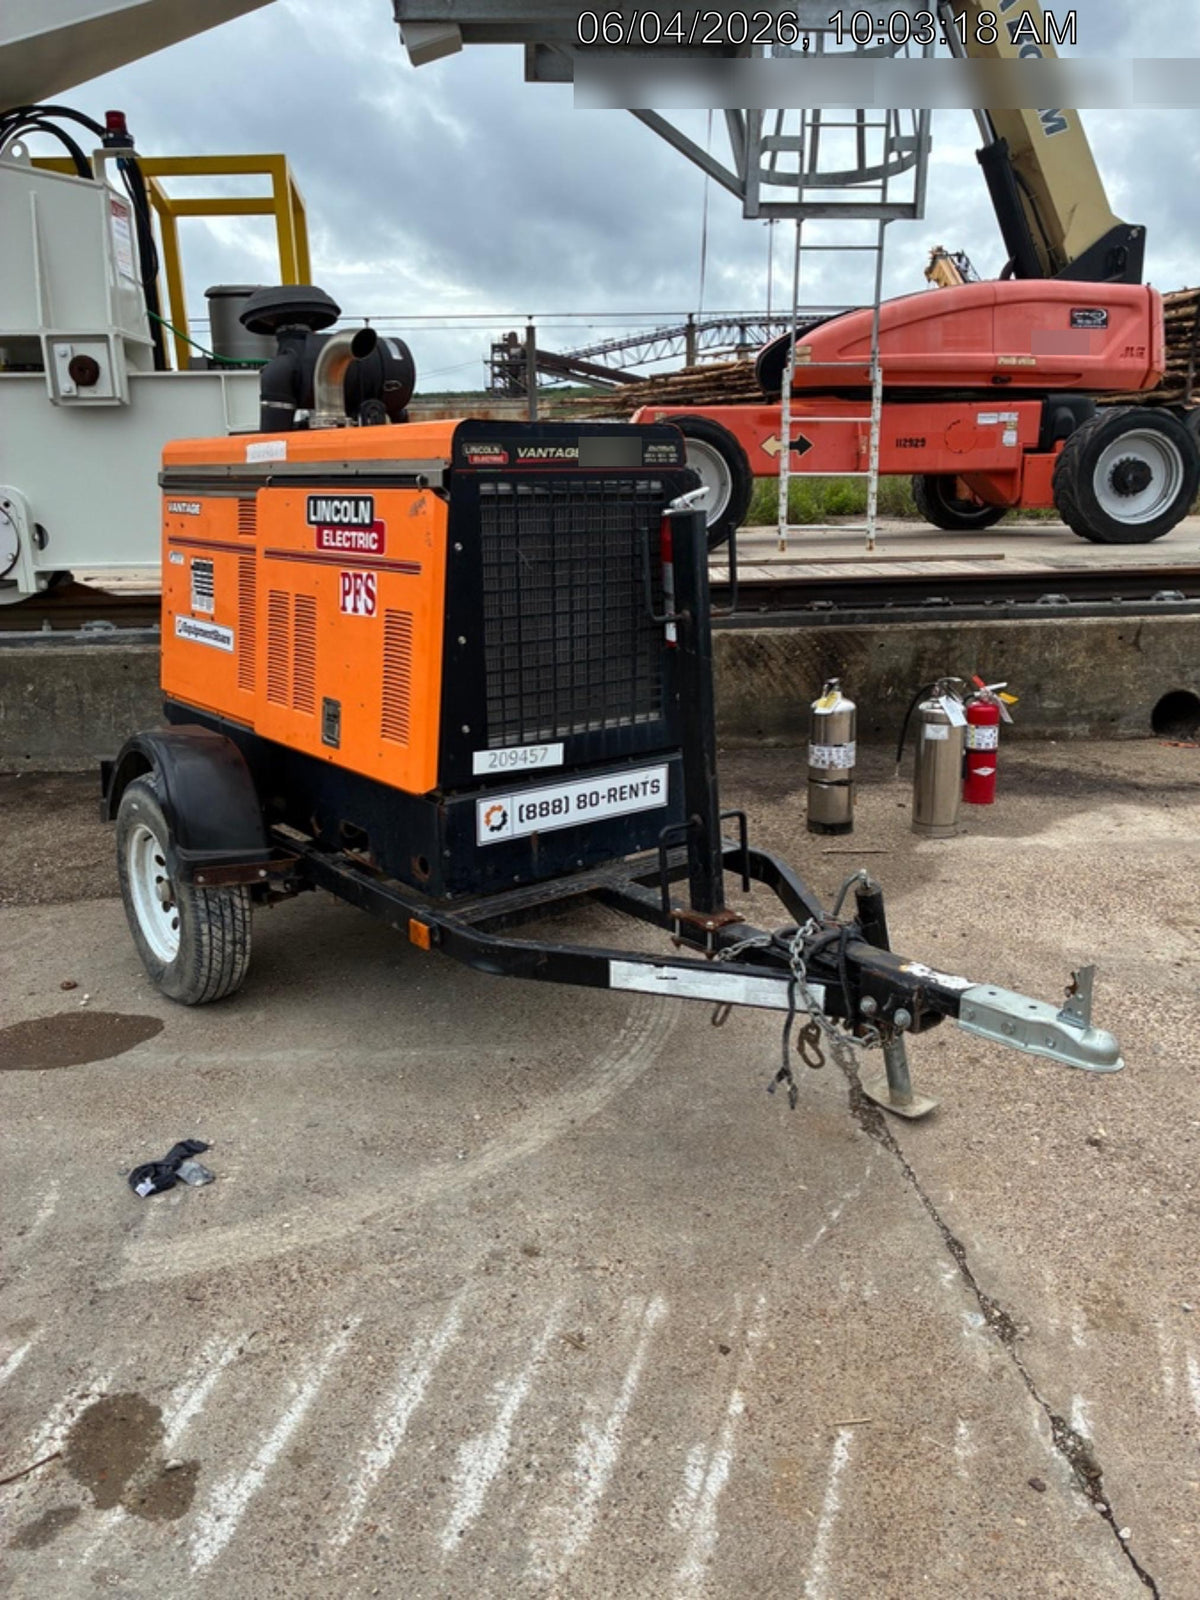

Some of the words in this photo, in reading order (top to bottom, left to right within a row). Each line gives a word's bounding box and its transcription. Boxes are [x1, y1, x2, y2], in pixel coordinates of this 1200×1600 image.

[167, 502, 201, 515] VANTAGE
[308, 499, 371, 524] LINCOLN
[322, 529, 378, 550] ELECTRIC
[340, 571, 376, 616] PFS
[488, 747, 549, 769] 209457
[518, 795, 570, 824] (888)
[576, 778, 661, 811] 80-RENTS
